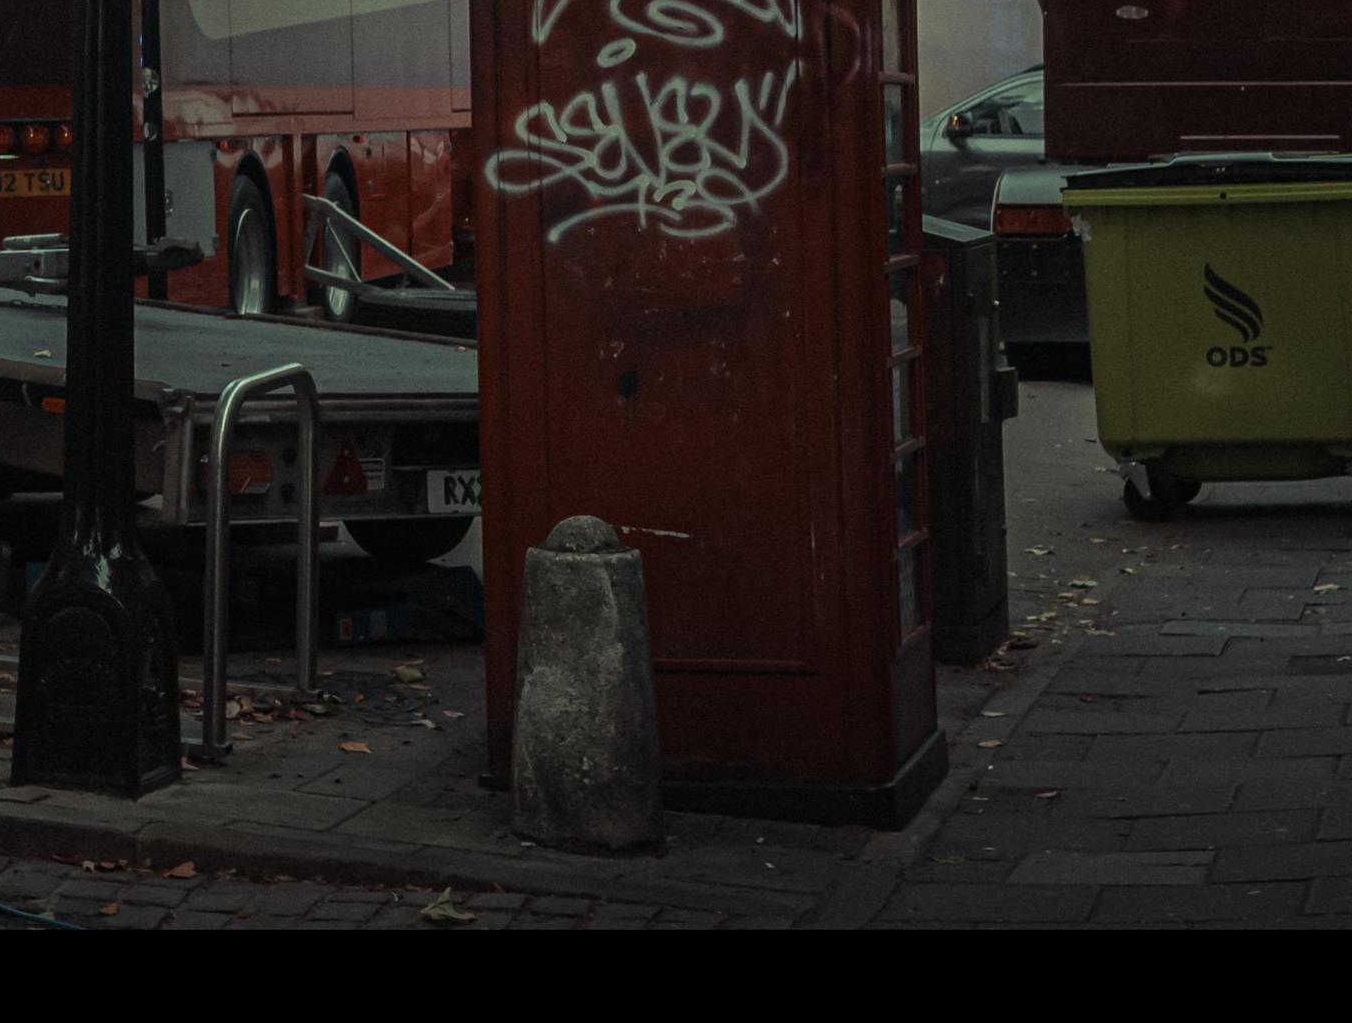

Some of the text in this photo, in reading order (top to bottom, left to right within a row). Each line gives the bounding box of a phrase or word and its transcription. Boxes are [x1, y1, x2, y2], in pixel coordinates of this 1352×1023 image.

[23, 170, 65, 192] TSU
[1206, 346, 1269, 367] ODS
[444, 475, 482, 506] RX
